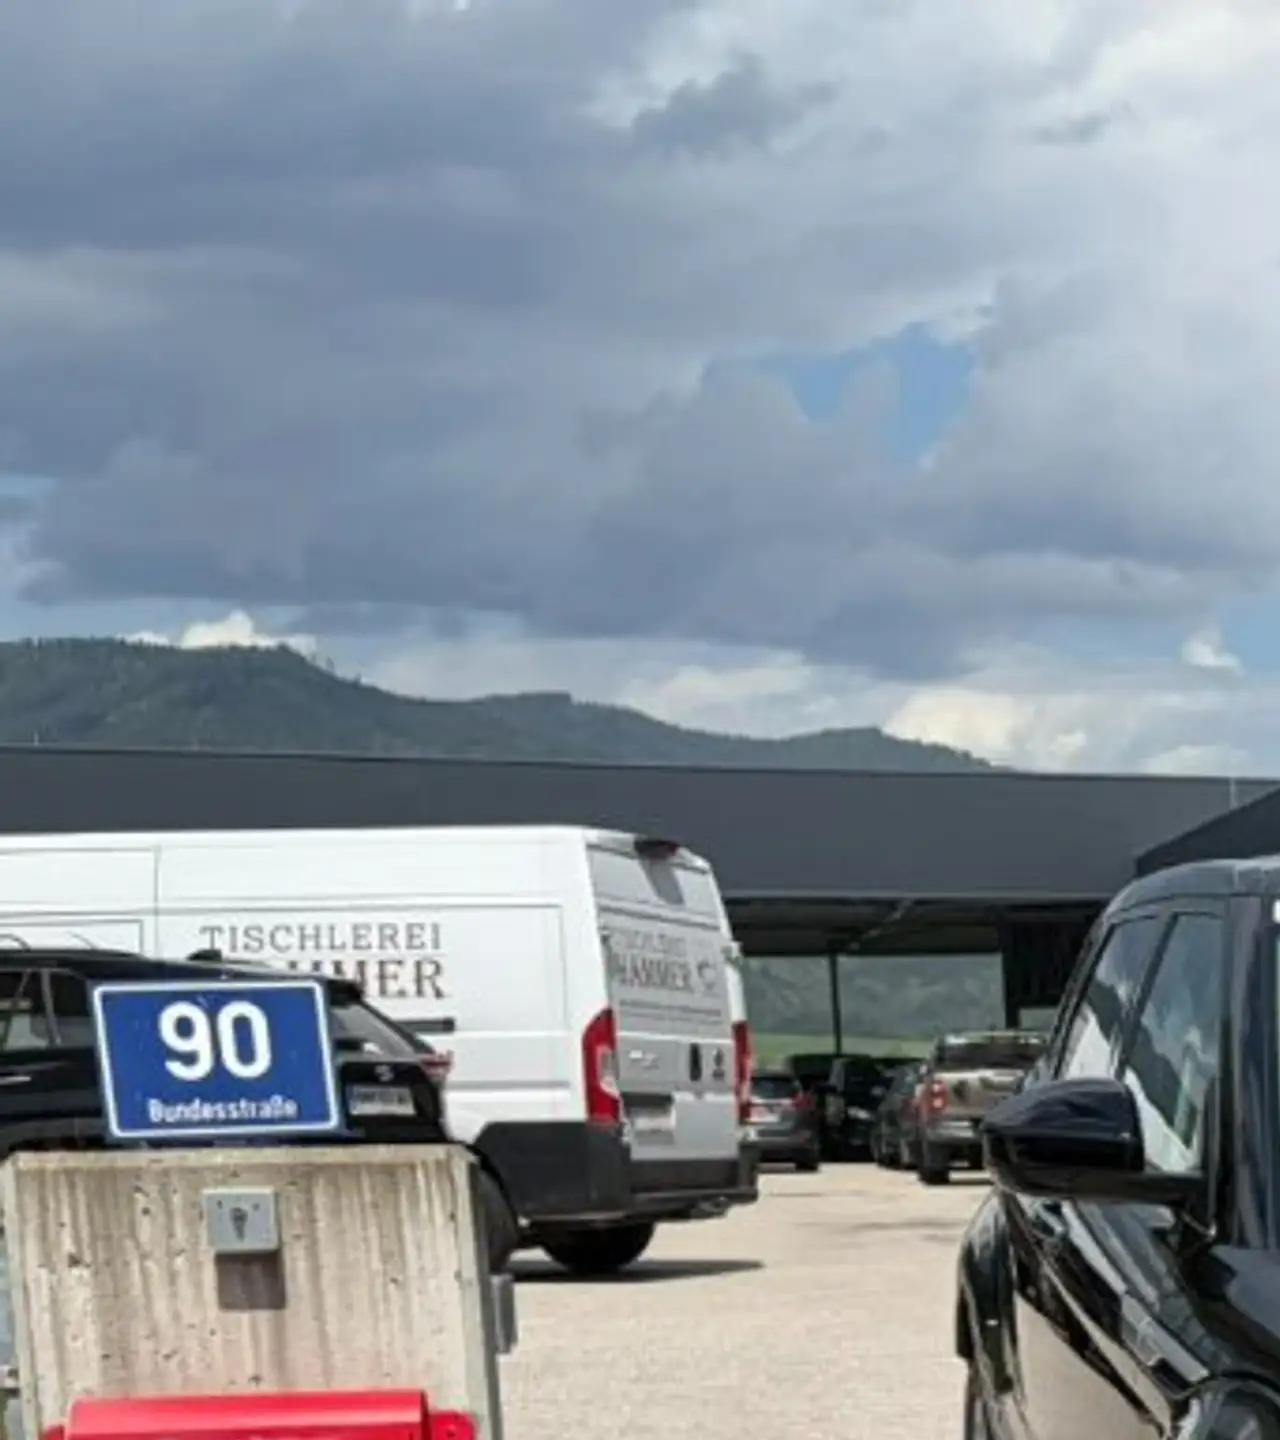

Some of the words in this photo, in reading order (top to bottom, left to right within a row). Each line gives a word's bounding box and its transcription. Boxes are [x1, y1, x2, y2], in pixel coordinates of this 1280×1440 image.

[199, 922, 441, 952] TISCHLEREI
[158, 1000, 272, 1081] 90
[148, 1094, 298, 1124] Bundesstraße
